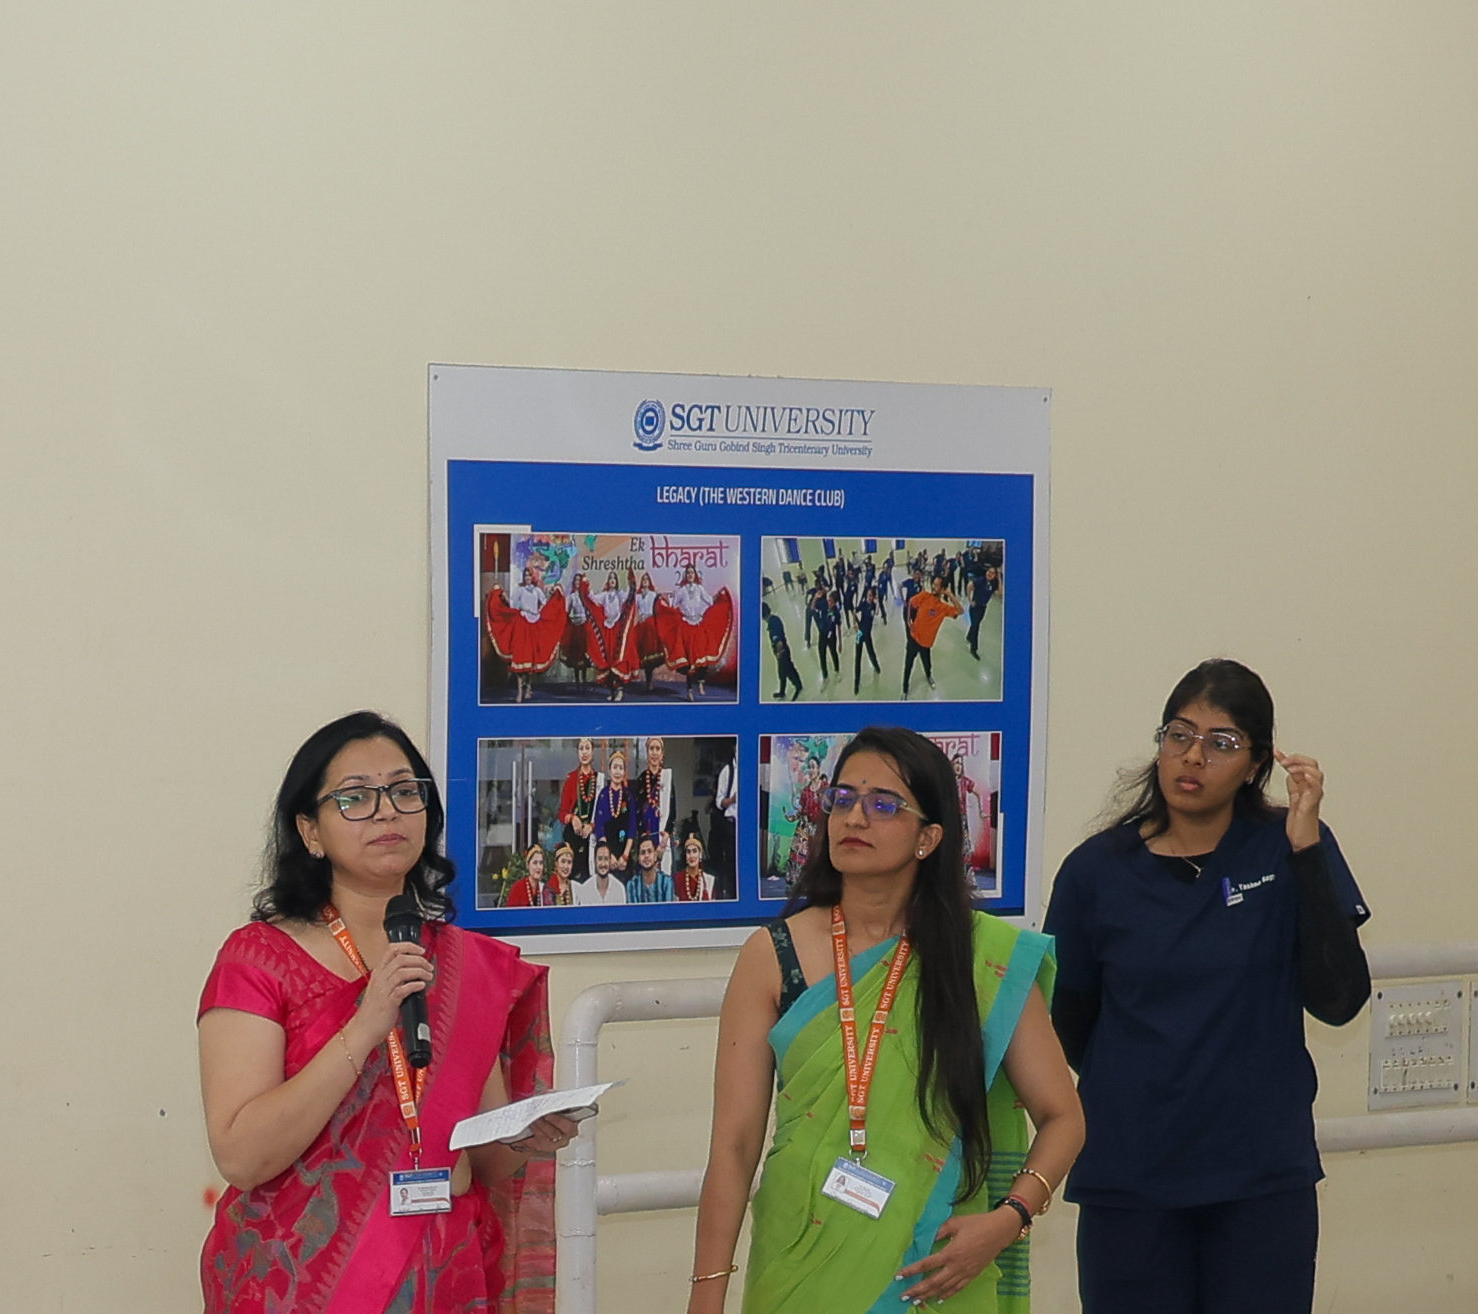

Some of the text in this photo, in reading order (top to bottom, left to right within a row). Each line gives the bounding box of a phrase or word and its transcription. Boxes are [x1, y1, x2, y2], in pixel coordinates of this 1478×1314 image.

[669, 403, 875, 436] SGT UNIVERSITY
[667, 439, 872, 458] Shree Guru Gobind Singh Tricentenary University
[656, 486, 845, 509] LEGACY (THE WESTERN DANCE CLUB)
[630, 536, 645, 552] Ek
[650, 535, 730, 569] bharat
[582, 555, 645, 571] Shreshtha
[835, 938, 851, 1006] SGT UNIVERSITY
[880, 940, 910, 1009] SGT UNIVERSITY
[844, 1024, 858, 1082] UNIVERSITY
[857, 1027, 880, 1104] SGT UNIVERSITY
[397, 1080, 410, 1101] SGT
